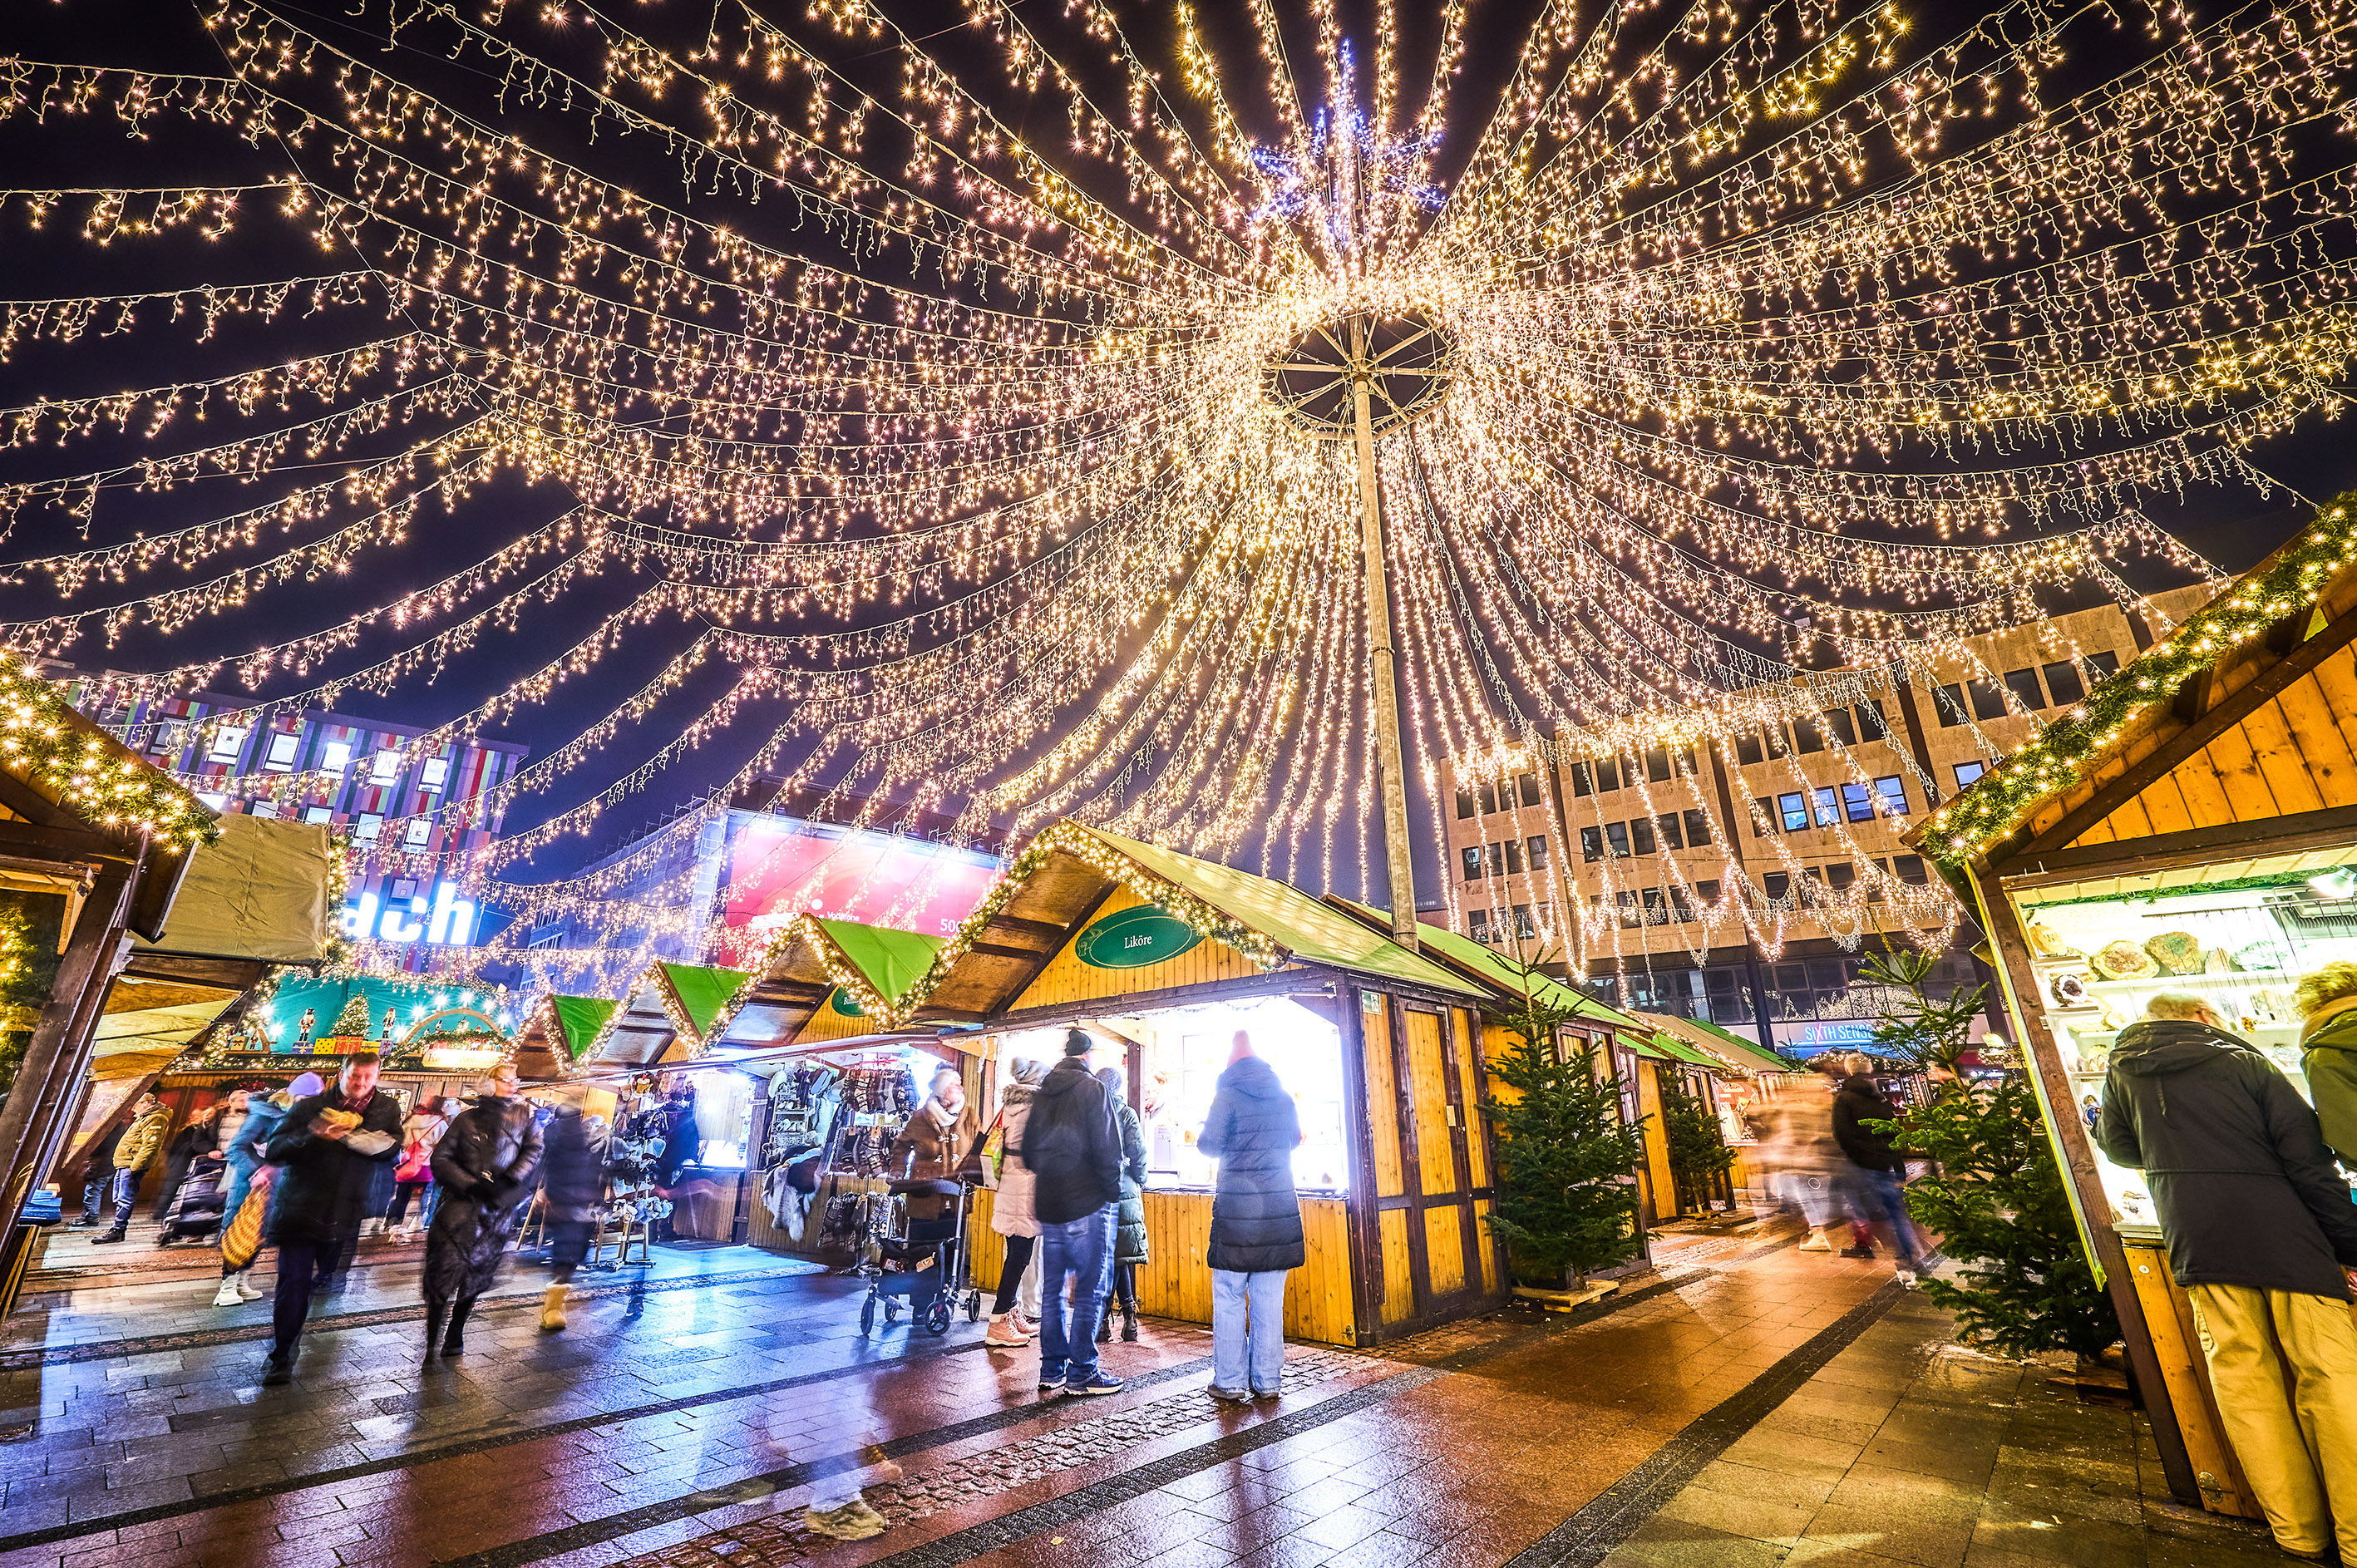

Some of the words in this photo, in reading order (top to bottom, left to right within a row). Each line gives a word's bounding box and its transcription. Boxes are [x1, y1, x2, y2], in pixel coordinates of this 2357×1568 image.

[826, 910, 860, 922] Vodafone
[1124, 934, 1152, 949] Liköre
[1805, 1022, 1837, 1044] SIXTH
[1838, 1023, 1874, 1039] SENSE
